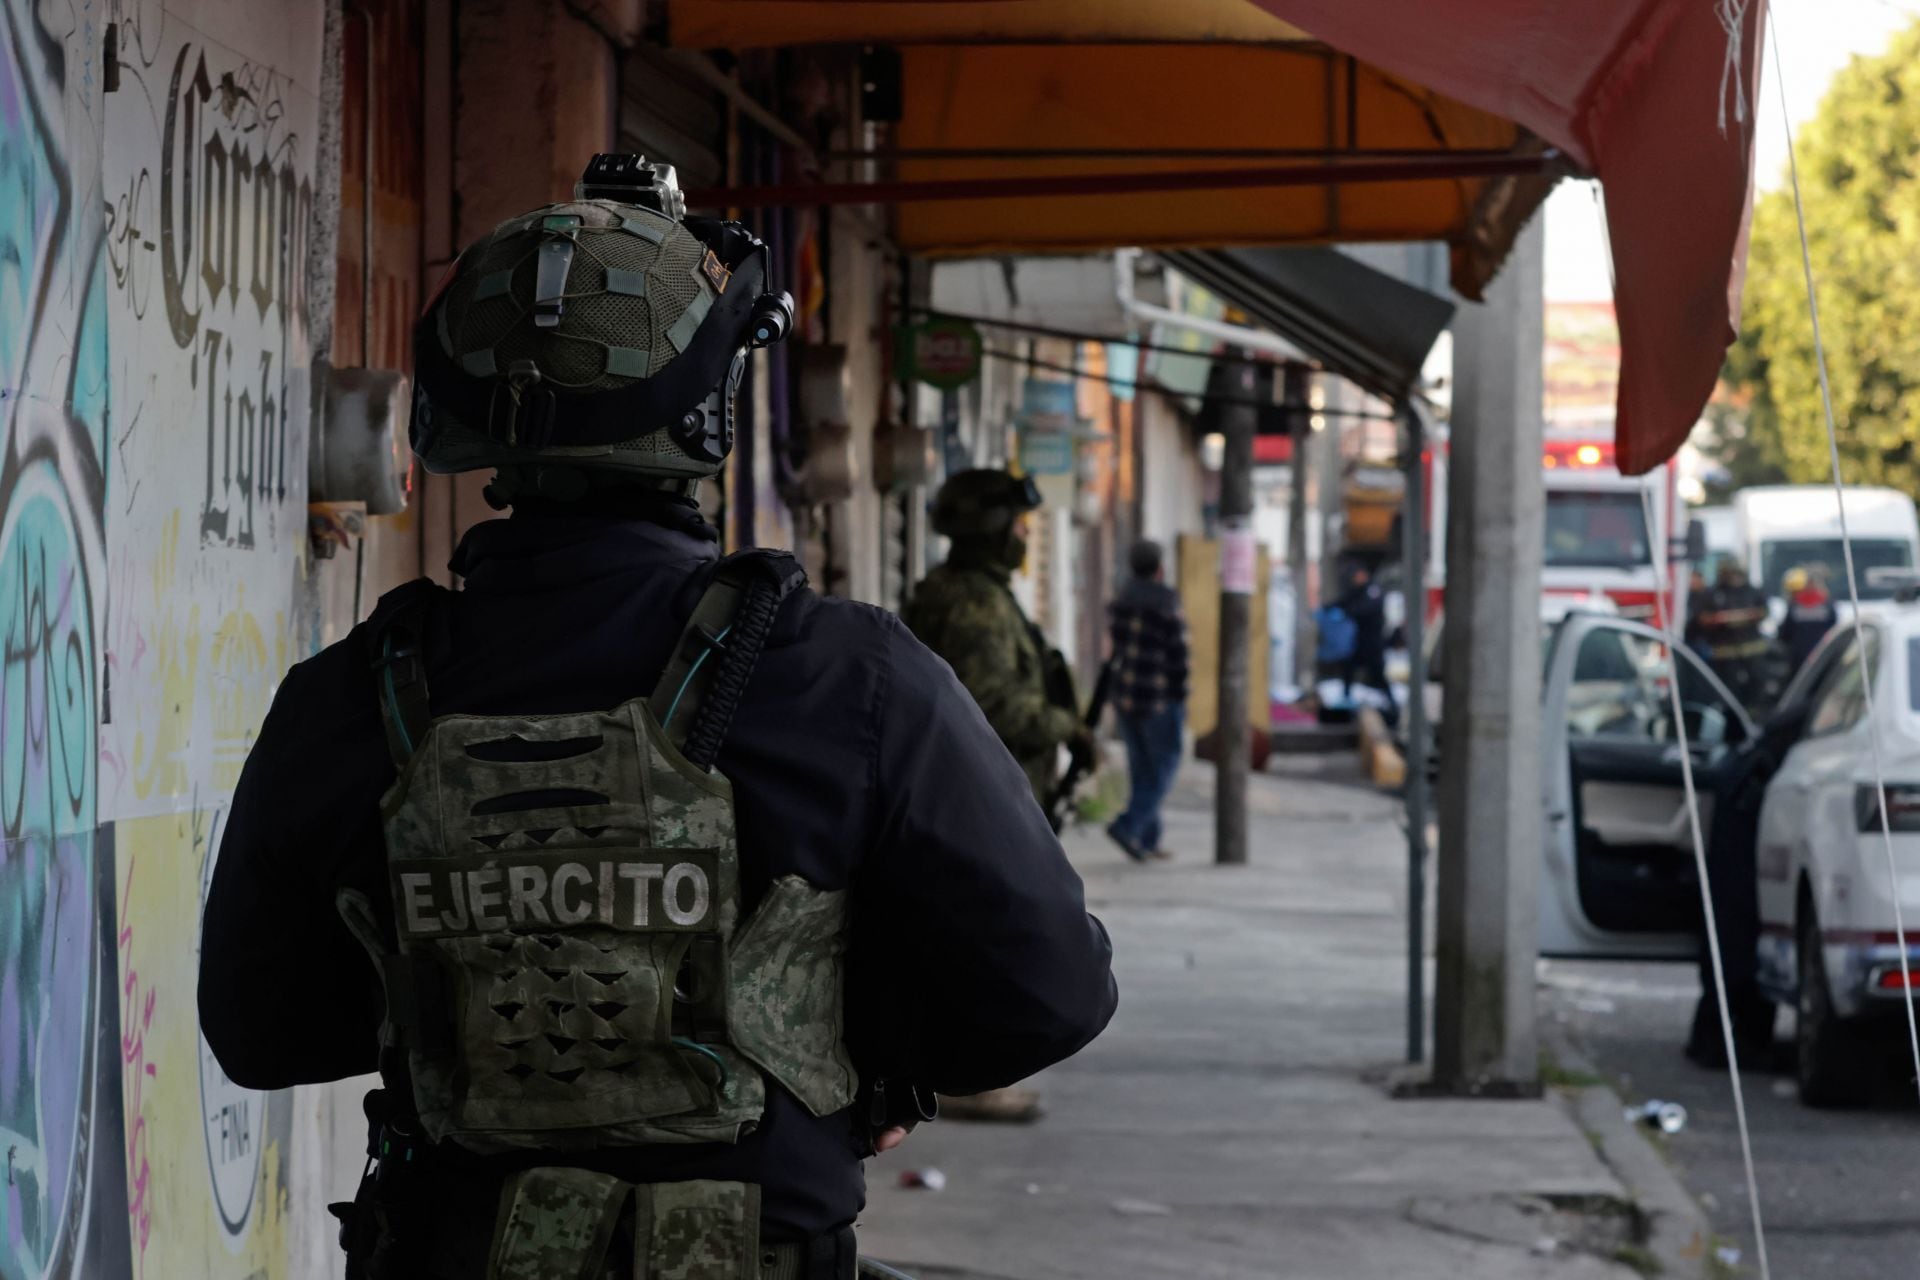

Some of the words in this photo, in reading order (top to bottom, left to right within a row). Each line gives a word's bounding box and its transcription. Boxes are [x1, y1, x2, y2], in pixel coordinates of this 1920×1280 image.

[161, 42, 315, 388] Corona
[200, 328, 287, 549] Light
[400, 860, 711, 933] EJÉRCITO
